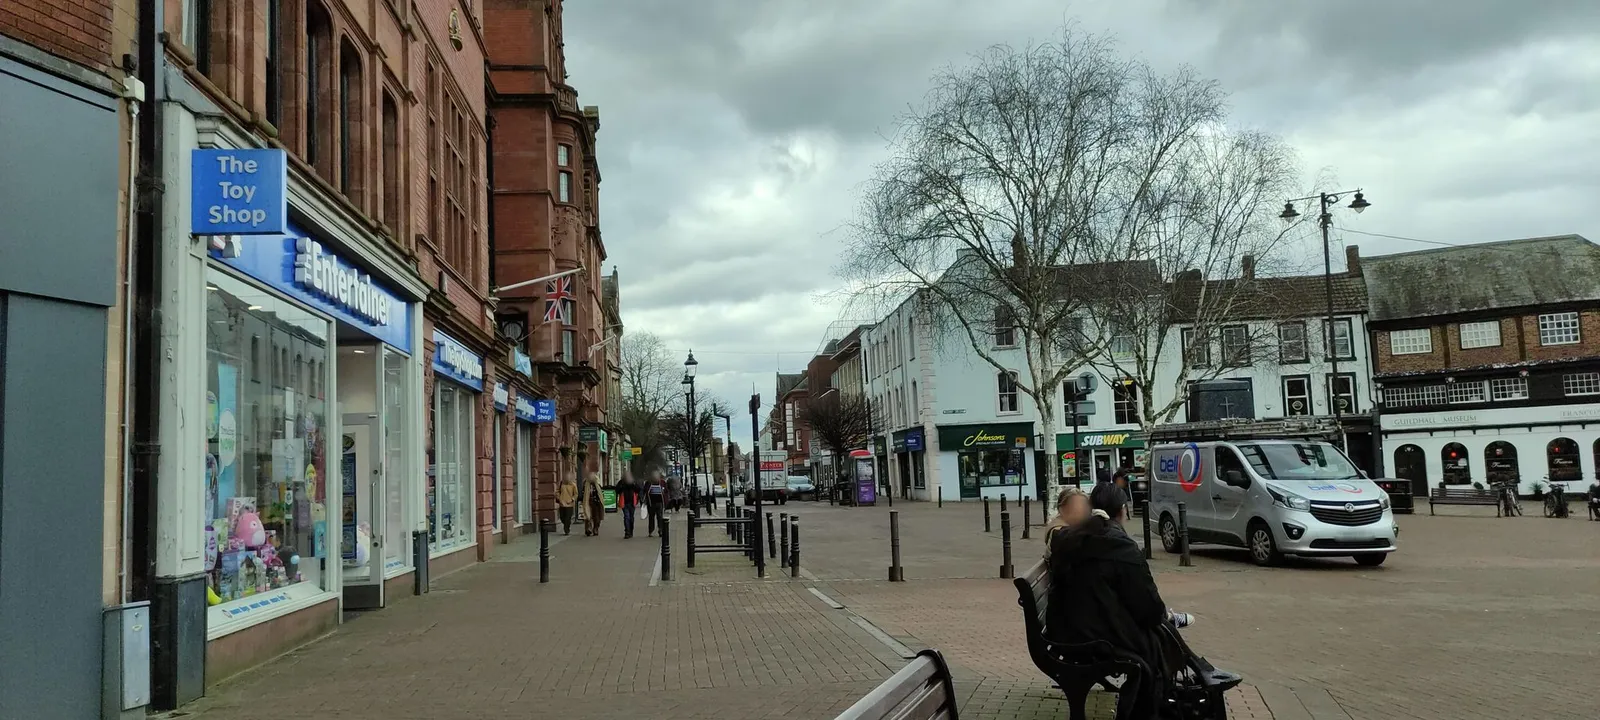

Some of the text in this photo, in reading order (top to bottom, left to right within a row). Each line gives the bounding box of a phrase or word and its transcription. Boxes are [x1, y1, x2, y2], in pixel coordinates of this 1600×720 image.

[217, 155, 258, 174] The
[219, 181, 256, 203] Toy
[208, 205, 266, 227] Shop
[312, 241, 391, 325] Entertainer
[1393, 415, 1477, 425] GUILDHALL MUSEUM
[963, 429, 1006, 447] Johnsons
[1081, 433, 1130, 447] SUBWAY
[1160, 455, 1179, 473] bell
